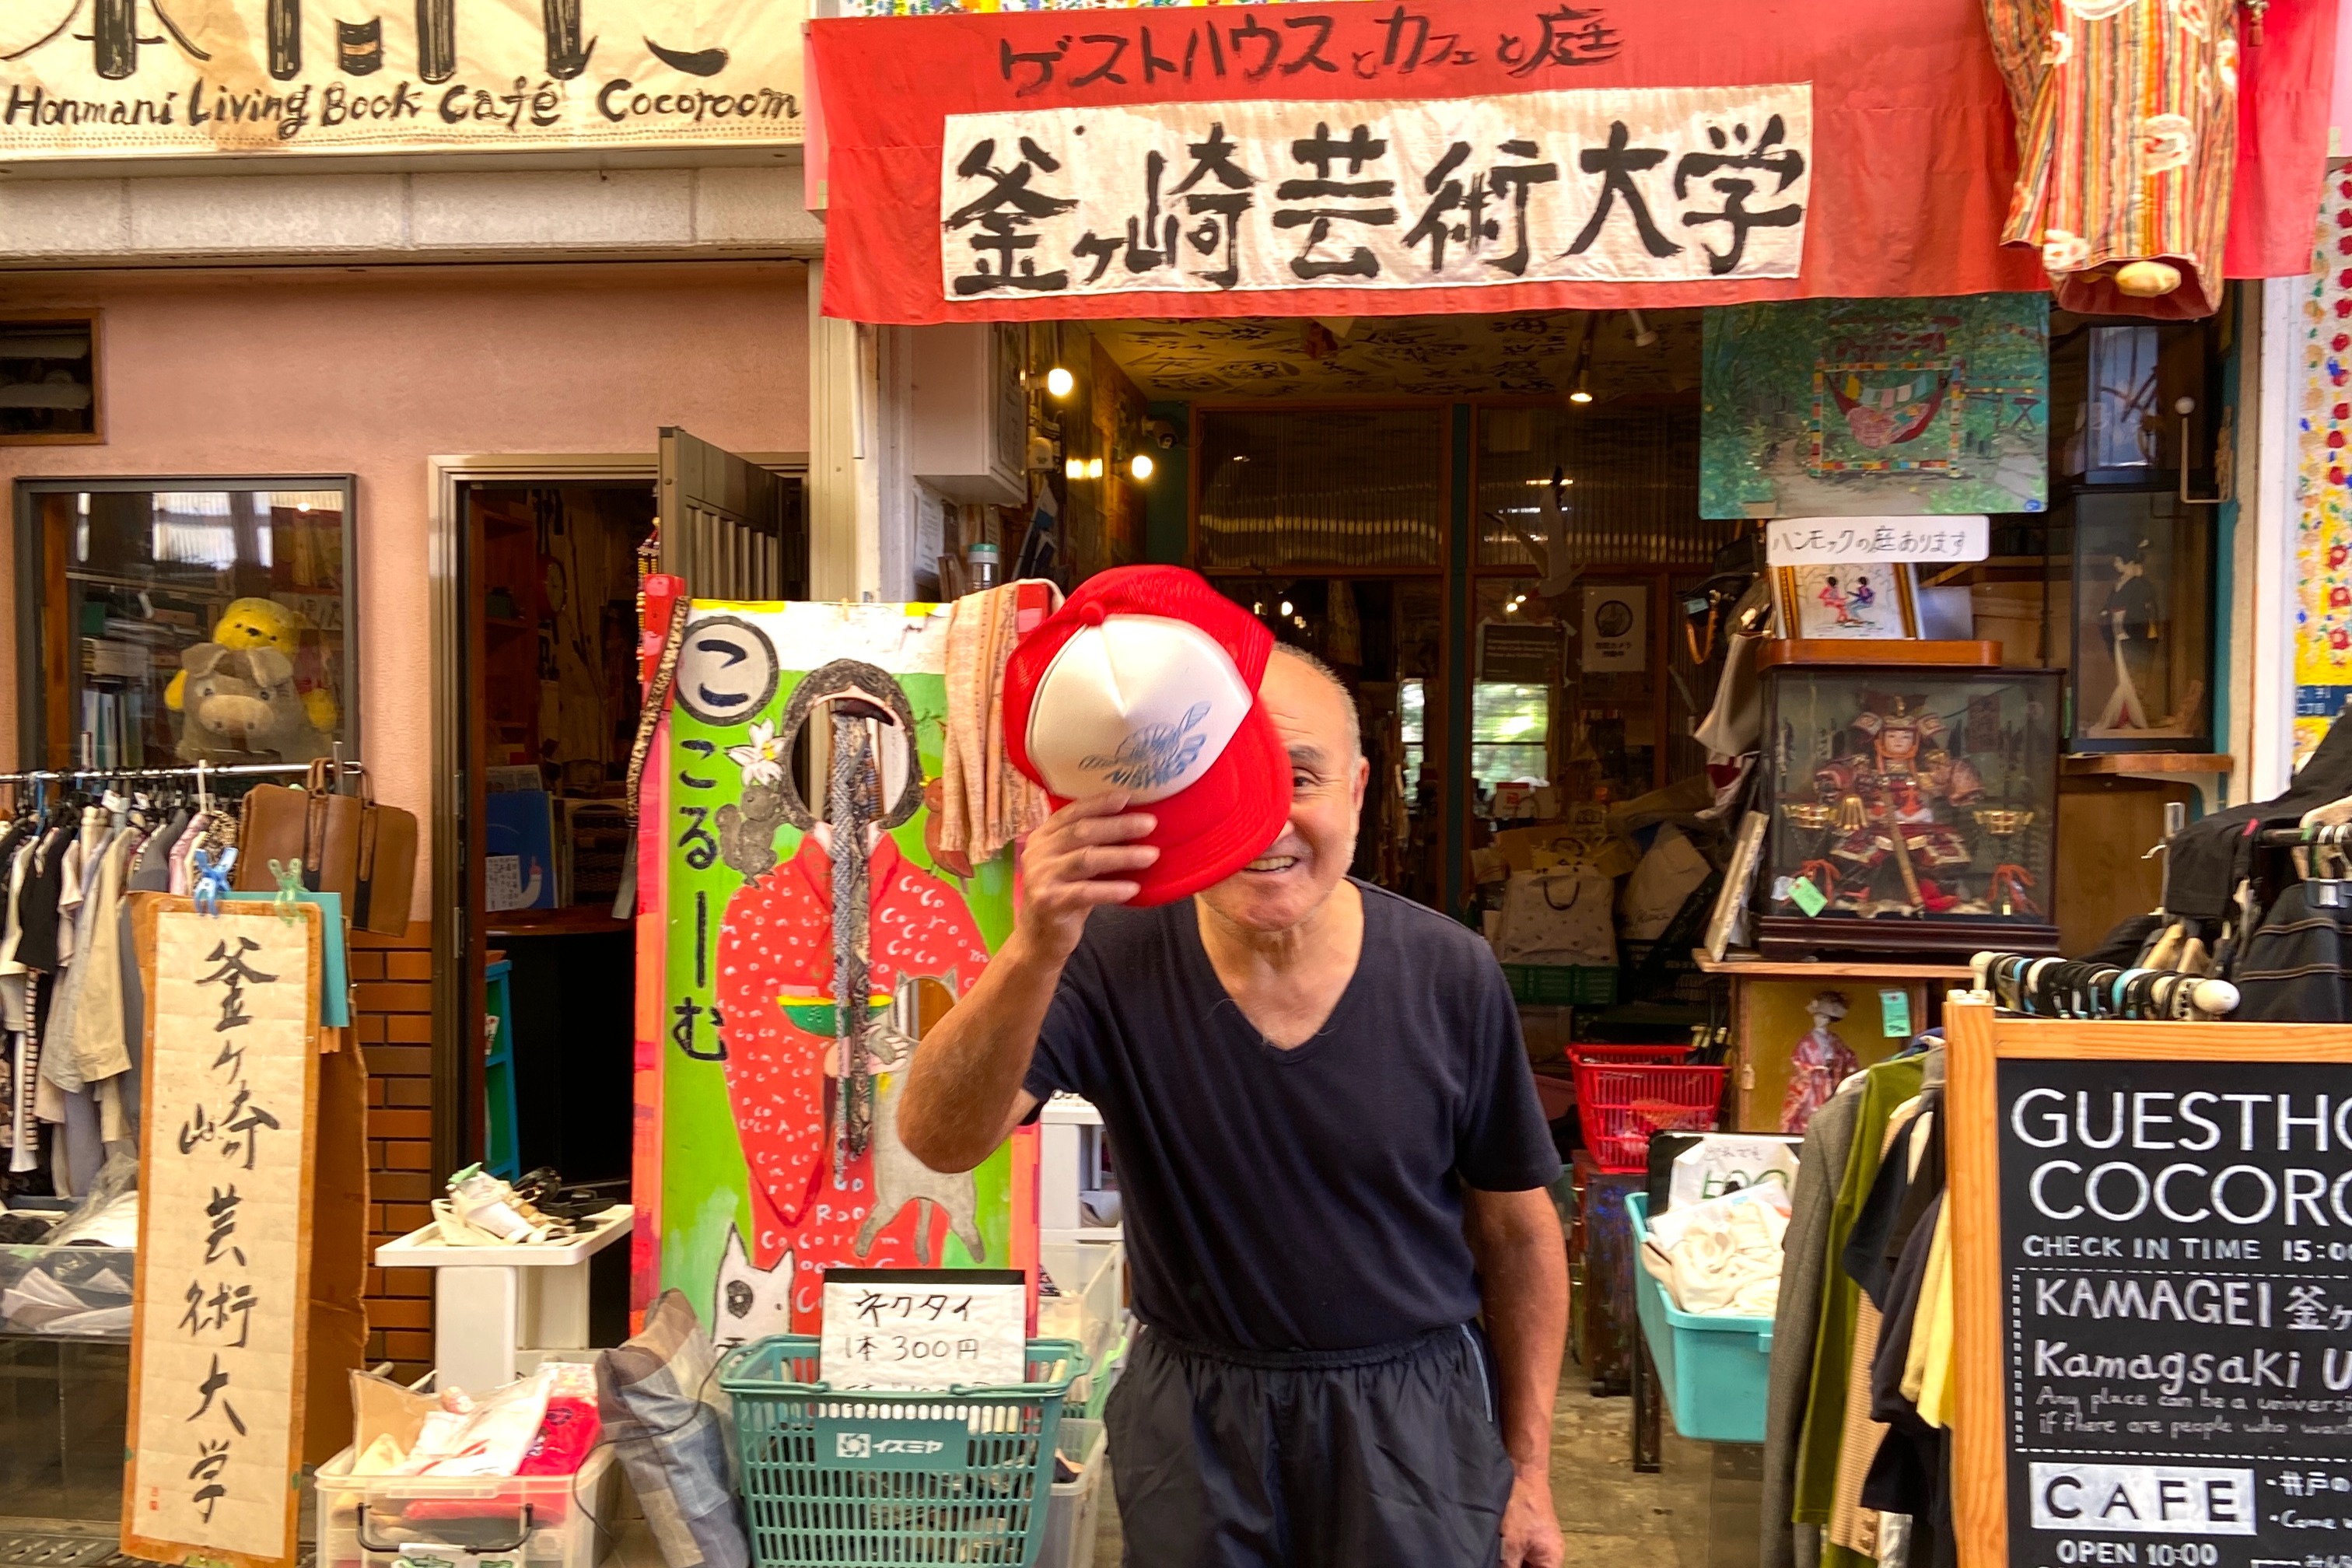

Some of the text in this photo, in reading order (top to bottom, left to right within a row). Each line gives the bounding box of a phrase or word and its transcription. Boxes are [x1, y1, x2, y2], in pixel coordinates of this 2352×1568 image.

[999, 6, 1626, 96] ゲストハウスとカフェと庭
[3, 76, 802, 140] Honmani Living Book Café Cocoroom
[1770, 525, 1966, 557] ハンモックの庭あります
[2022, 1234, 2124, 1258] CHECK
[2133, 1237, 2170, 1261] IN
[2179, 1237, 2262, 1261] TIME
[856, 1289, 975, 1328] ネクタイ
[2035, 1277, 2272, 1328] KAMAGEI
[2035, 1385, 2081, 1412] Any
[2091, 1387, 2149, 1414] place
[2157, 1395, 2193, 1409] can
[2200, 1388, 2227, 1409] be
[2231, 1397, 2249, 1410] a
[2039, 1410, 2059, 1434] if
[2063, 1410, 2118, 1433] there
[2126, 1420, 2165, 1434] are
[2170, 1414, 2233, 1440] people
[2243, 1415, 2288, 1433] who
[2046, 1475, 2240, 1523] CAFE
[2056, 1539, 2218, 1567] OPEN 10:00
